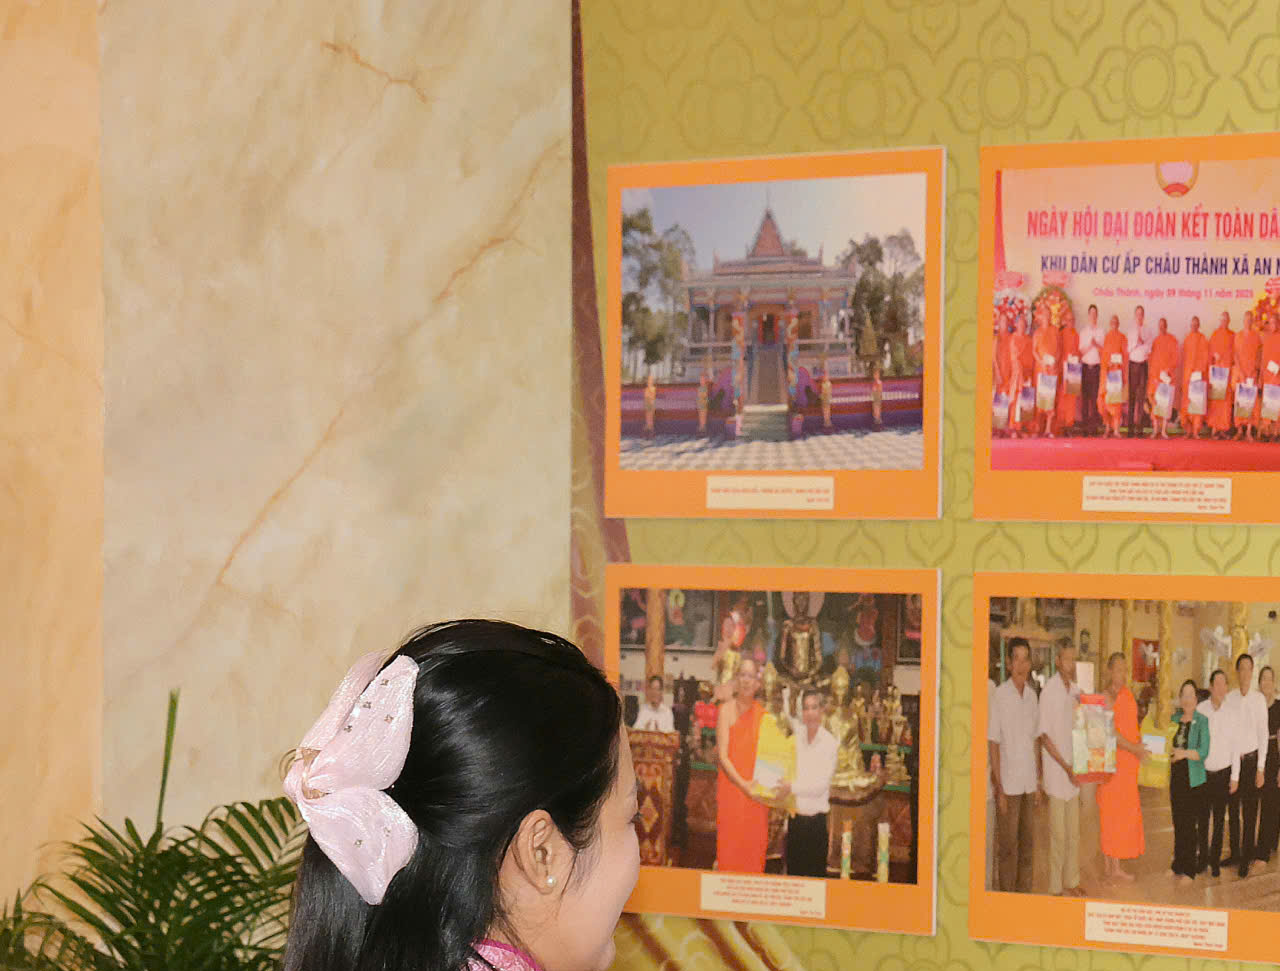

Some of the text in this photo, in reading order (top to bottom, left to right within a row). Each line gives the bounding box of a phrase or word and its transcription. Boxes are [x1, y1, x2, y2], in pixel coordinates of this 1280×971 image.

[1027, 206, 1068, 238] NGÀY
[1073, 205, 1098, 246] HỘI
[1103, 211, 1129, 246] ĐẠI
[1133, 206, 1177, 238] ĐOÀN
[1181, 203, 1209, 239] KẾT
[1214, 207, 1254, 239] TOÀN
[1071, 252, 1098, 273] DÂN
[1145, 252, 1181, 274] CHÂU
[1185, 253, 1228, 275] THÀNH
[1253, 257, 1272, 275] AN
